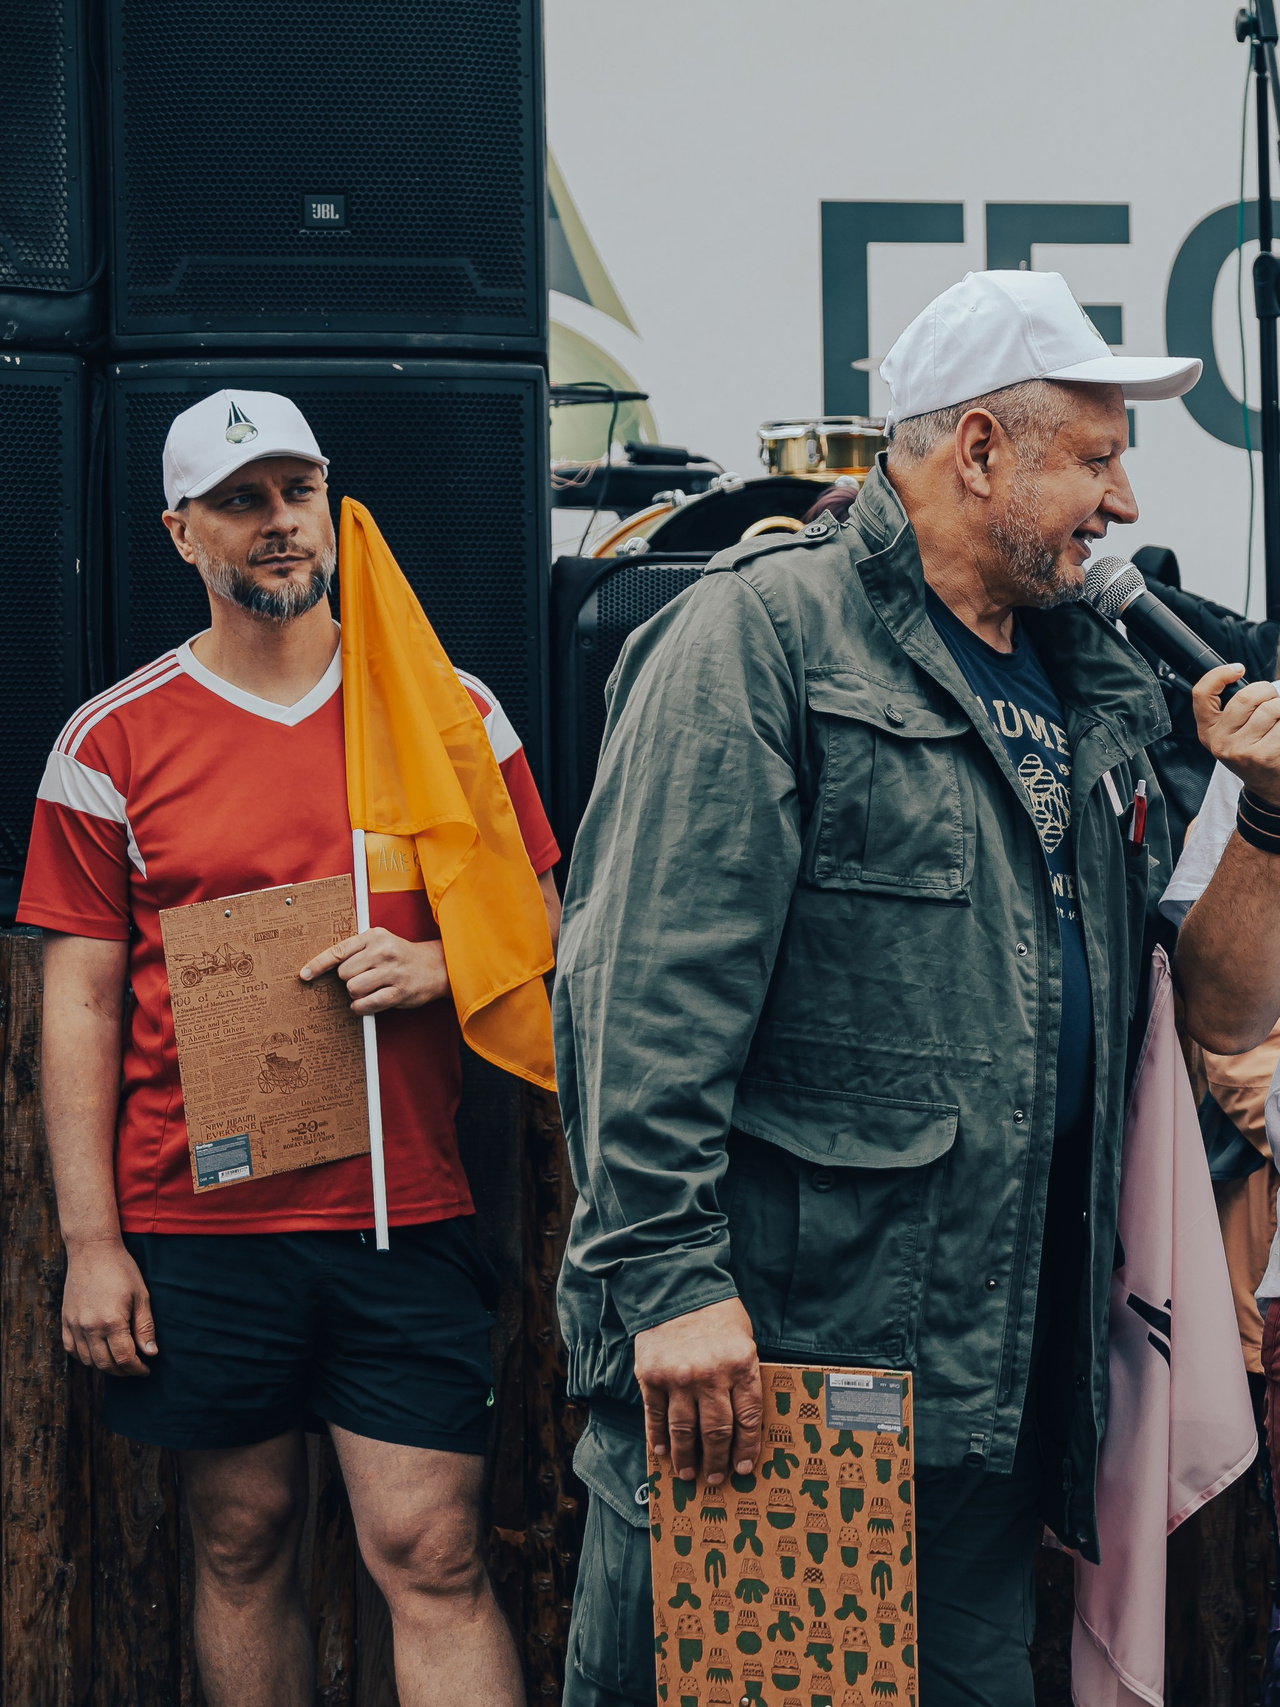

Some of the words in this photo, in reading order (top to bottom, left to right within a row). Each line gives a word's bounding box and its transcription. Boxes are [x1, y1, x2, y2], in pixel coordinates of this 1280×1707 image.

[311, 203, 340, 219] JBL
[977, 695, 1072, 757] UME
[216, 989, 234, 1000] An
[241, 981, 269, 994] Inch
[181, 1026, 192, 1035] this
[208, 1020, 220, 1029] and
[188, 1032, 210, 1043] Ahead
[213, 1030, 220, 1038] of
[223, 1026, 246, 1035] Others
[313, 1026, 333, 1035] CHINA
[321, 1082, 342, 1091] GREAT
[301, 1097, 320, 1107] Dread
[205, 1121, 224, 1133] NEW
[227, 1113, 256, 1127] HEALTH
[297, 1120, 319, 1135] 20
[206, 1121, 257, 1141] EVERYONE
[309, 1131, 326, 1139] TEAM
[876, 1424, 902, 1432] Berlingo
